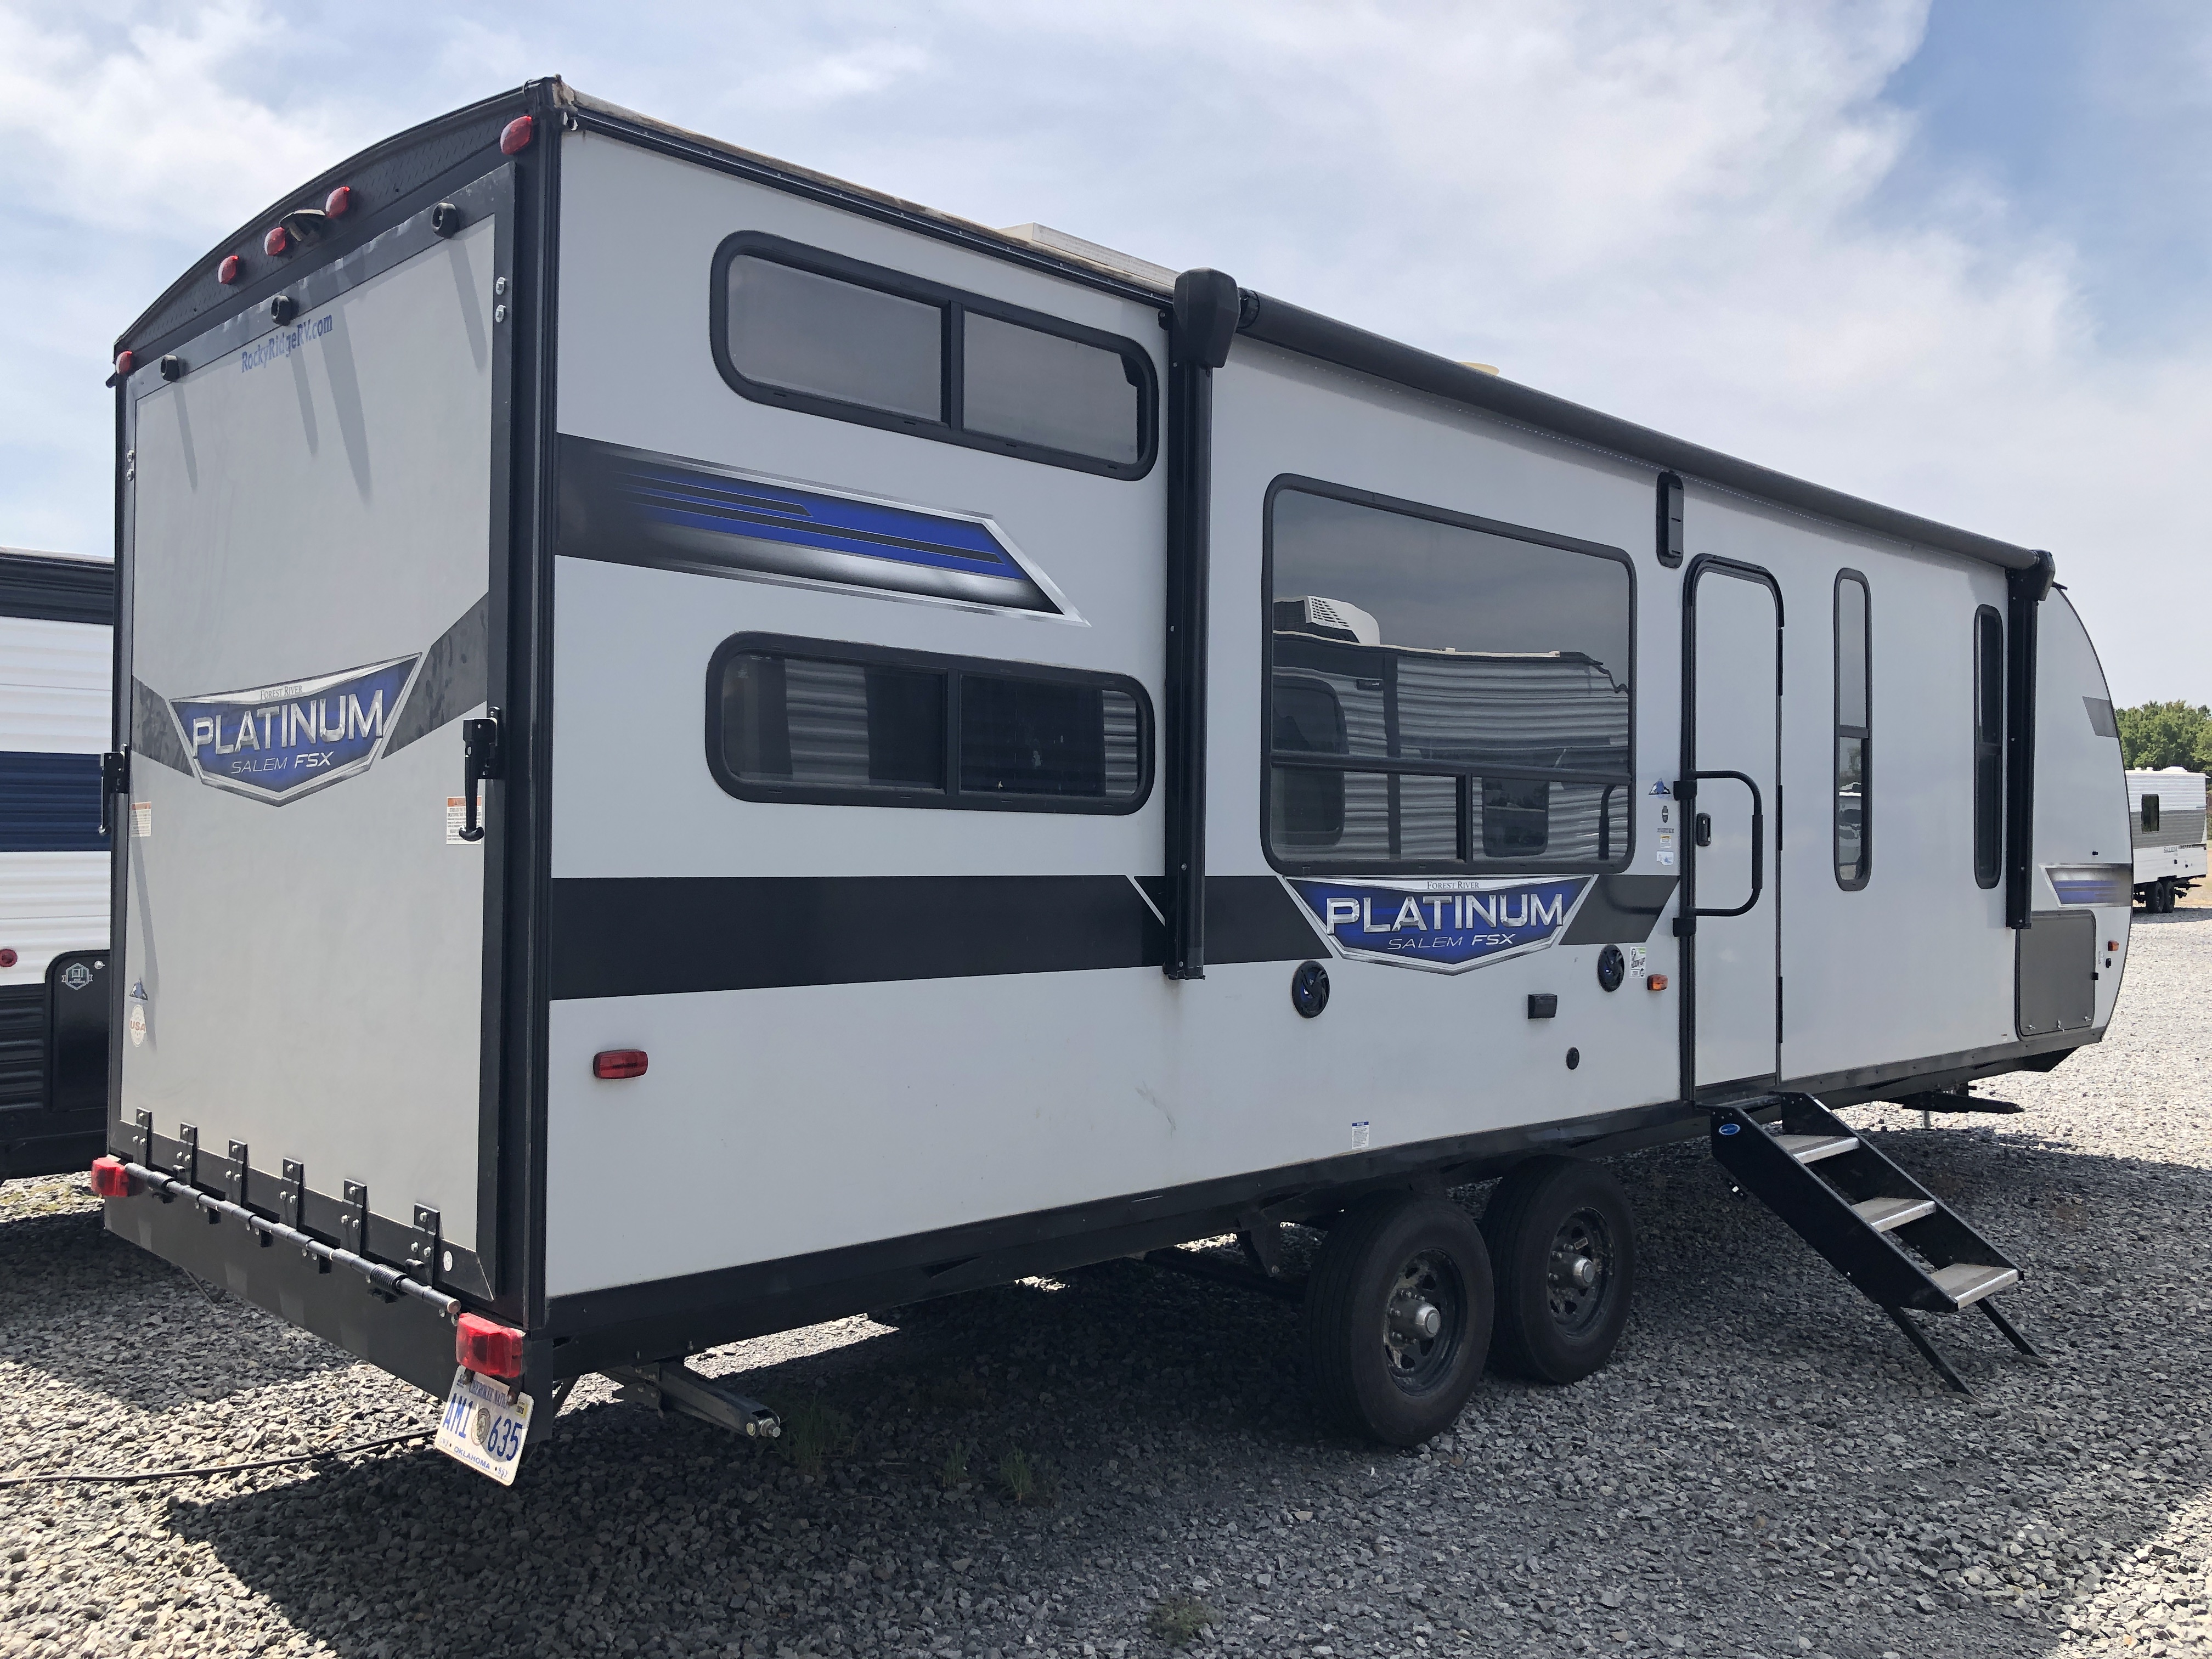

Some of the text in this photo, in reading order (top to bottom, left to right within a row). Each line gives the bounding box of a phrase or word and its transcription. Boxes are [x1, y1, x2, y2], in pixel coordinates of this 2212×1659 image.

[241, 314, 333, 373] RockyRidgeRV.com
[260, 685, 303, 700] FOREST RIVER
[193, 689, 383, 759] PLATINUM
[230, 751, 335, 775] SALEM FSX
[1427, 881, 1480, 889] FOREST RIVER
[1326, 894, 1563, 934] PLATINUM
[1387, 933, 1517, 950] SALEM FSX
[129, 1020, 146, 1032] USA
[487, 1415, 523, 1462] 635
[454, 1446, 490, 1470] OKLAHOMA
